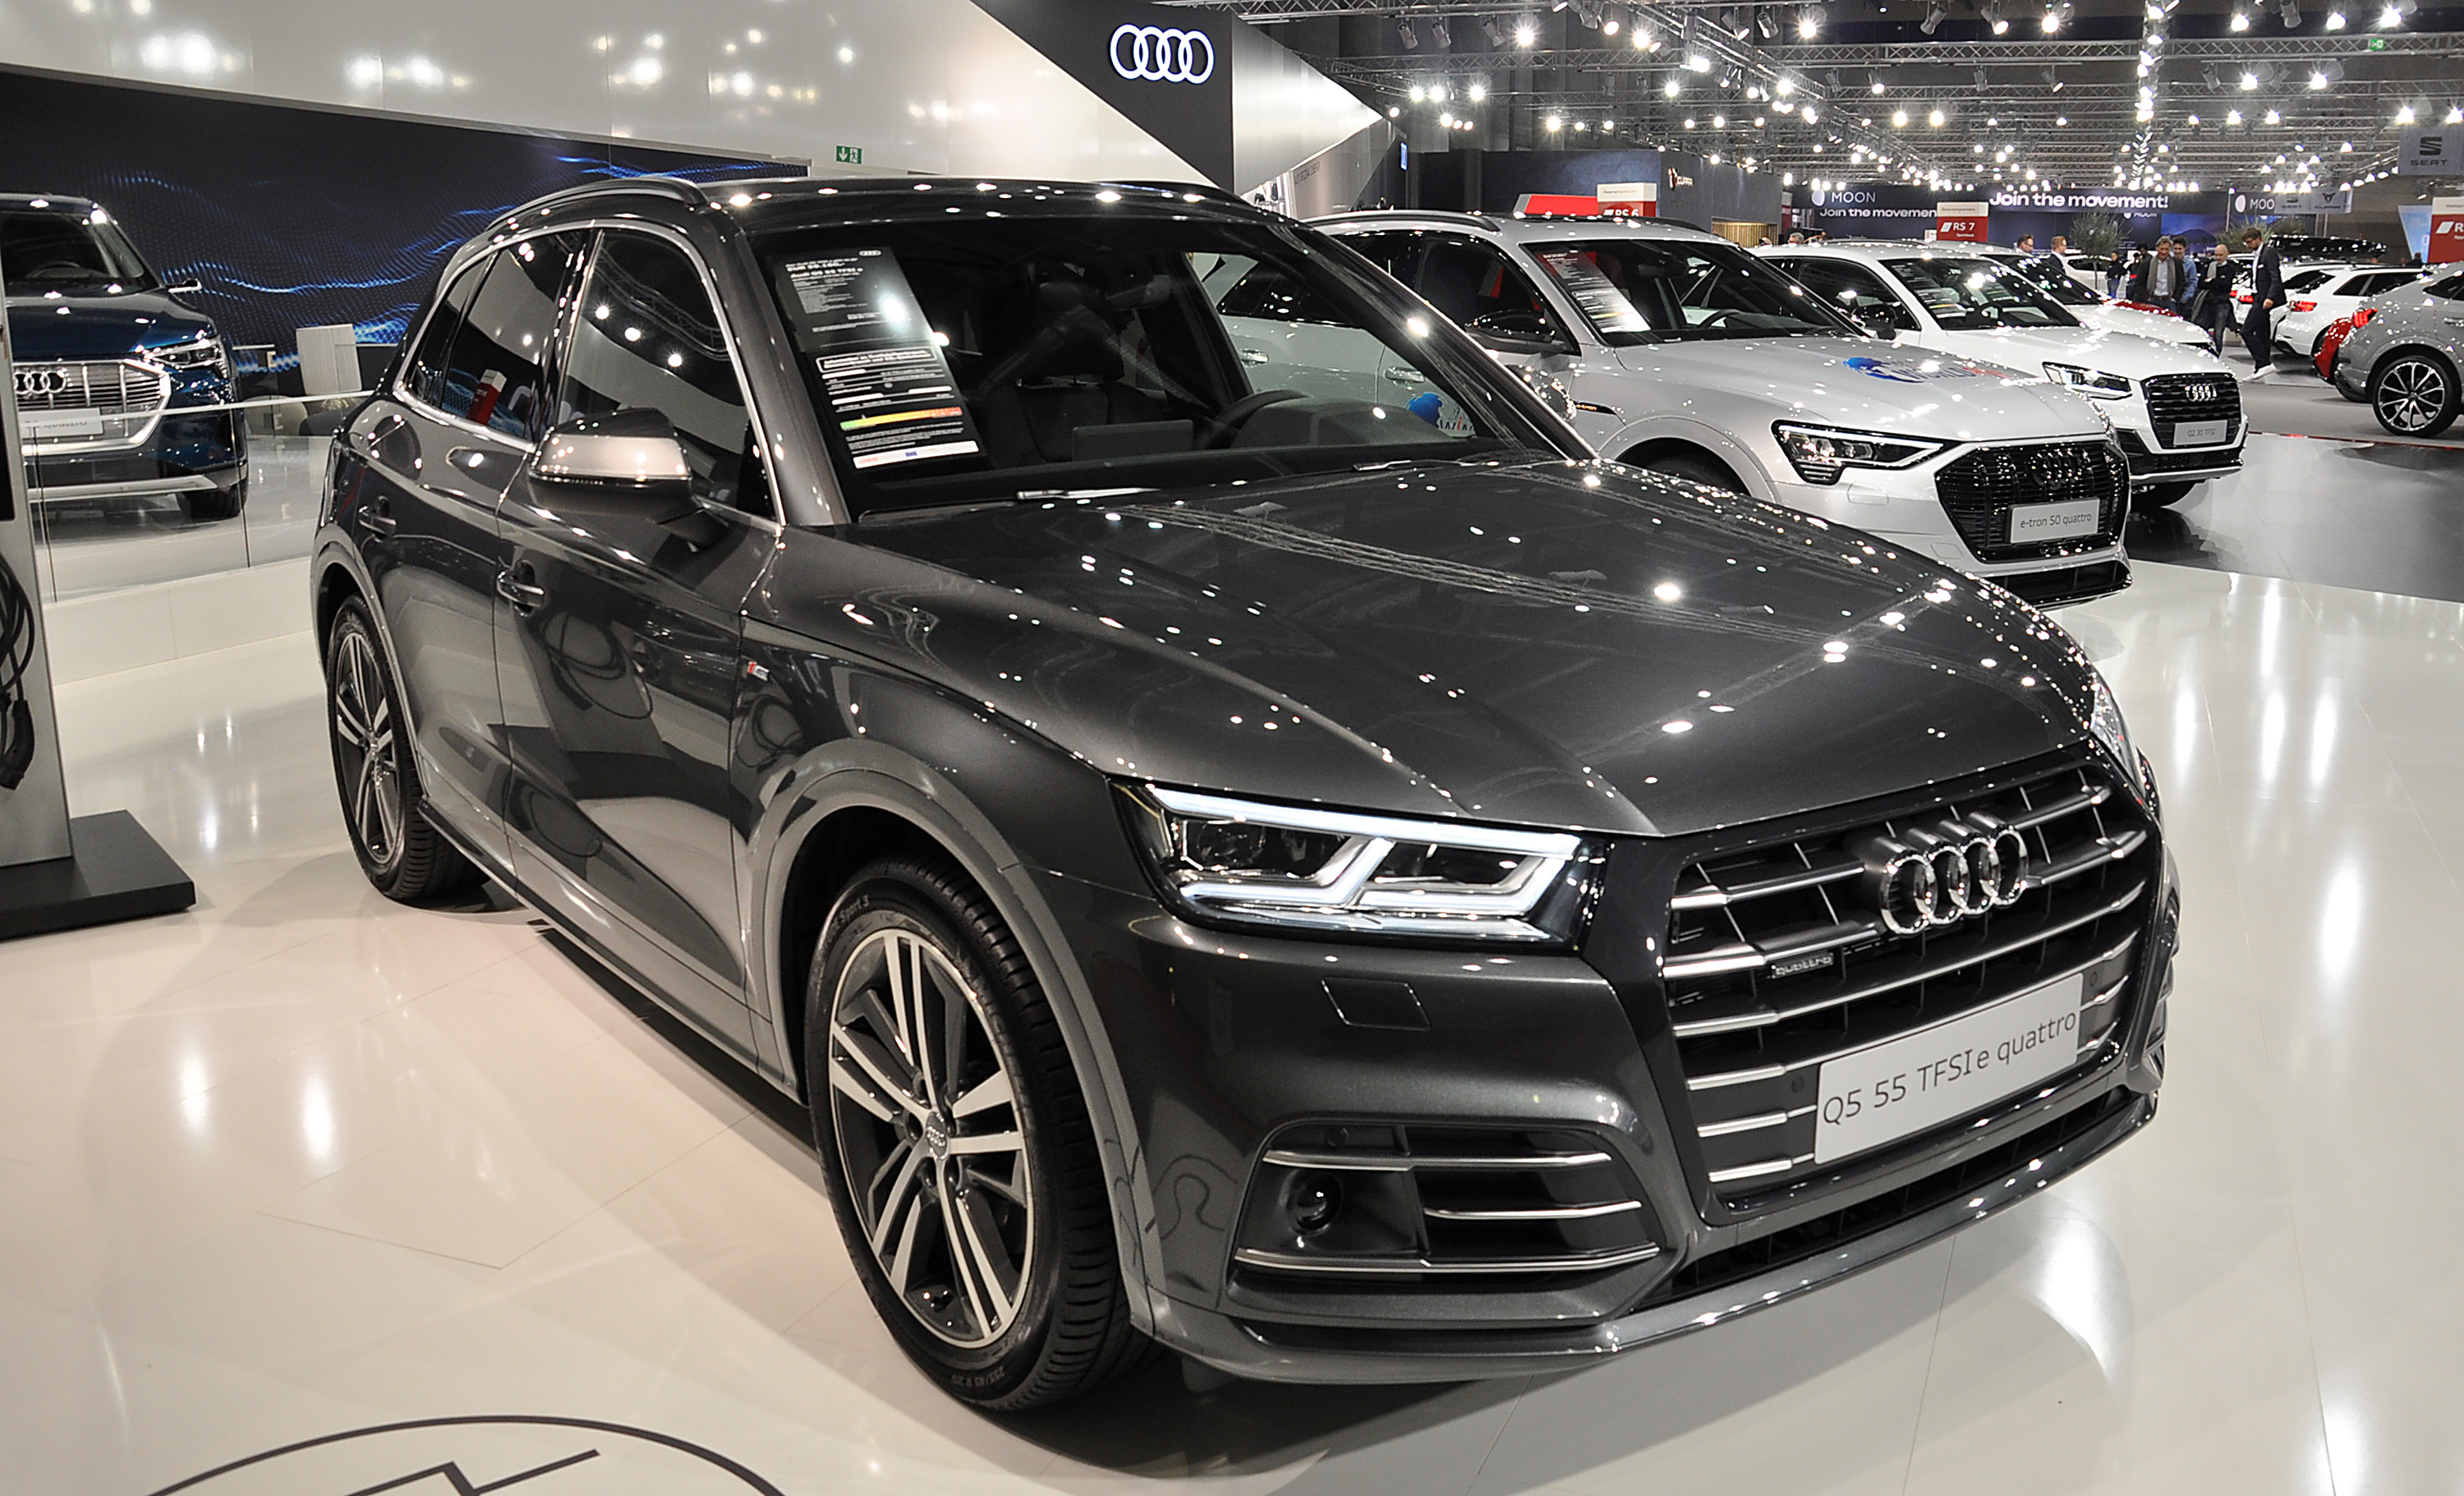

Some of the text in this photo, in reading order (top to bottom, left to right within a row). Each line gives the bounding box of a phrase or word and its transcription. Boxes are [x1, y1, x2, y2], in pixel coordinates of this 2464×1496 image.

[1831, 191, 1876, 204] MOON
[1988, 191, 2169, 209] Join the movement!
[2250, 198, 2275, 209] MOO
[1820, 208, 1938, 218] Join the movemen
[1952, 222, 1975, 231] RS 7
[2020, 513, 2093, 528] e-tron 50 quattro
[1775, 955, 1832, 976] quattro
[1823, 1089, 1862, 1125] Q5
[1873, 1075, 1907, 1109] 55
[1997, 1011, 2077, 1066] quattro
